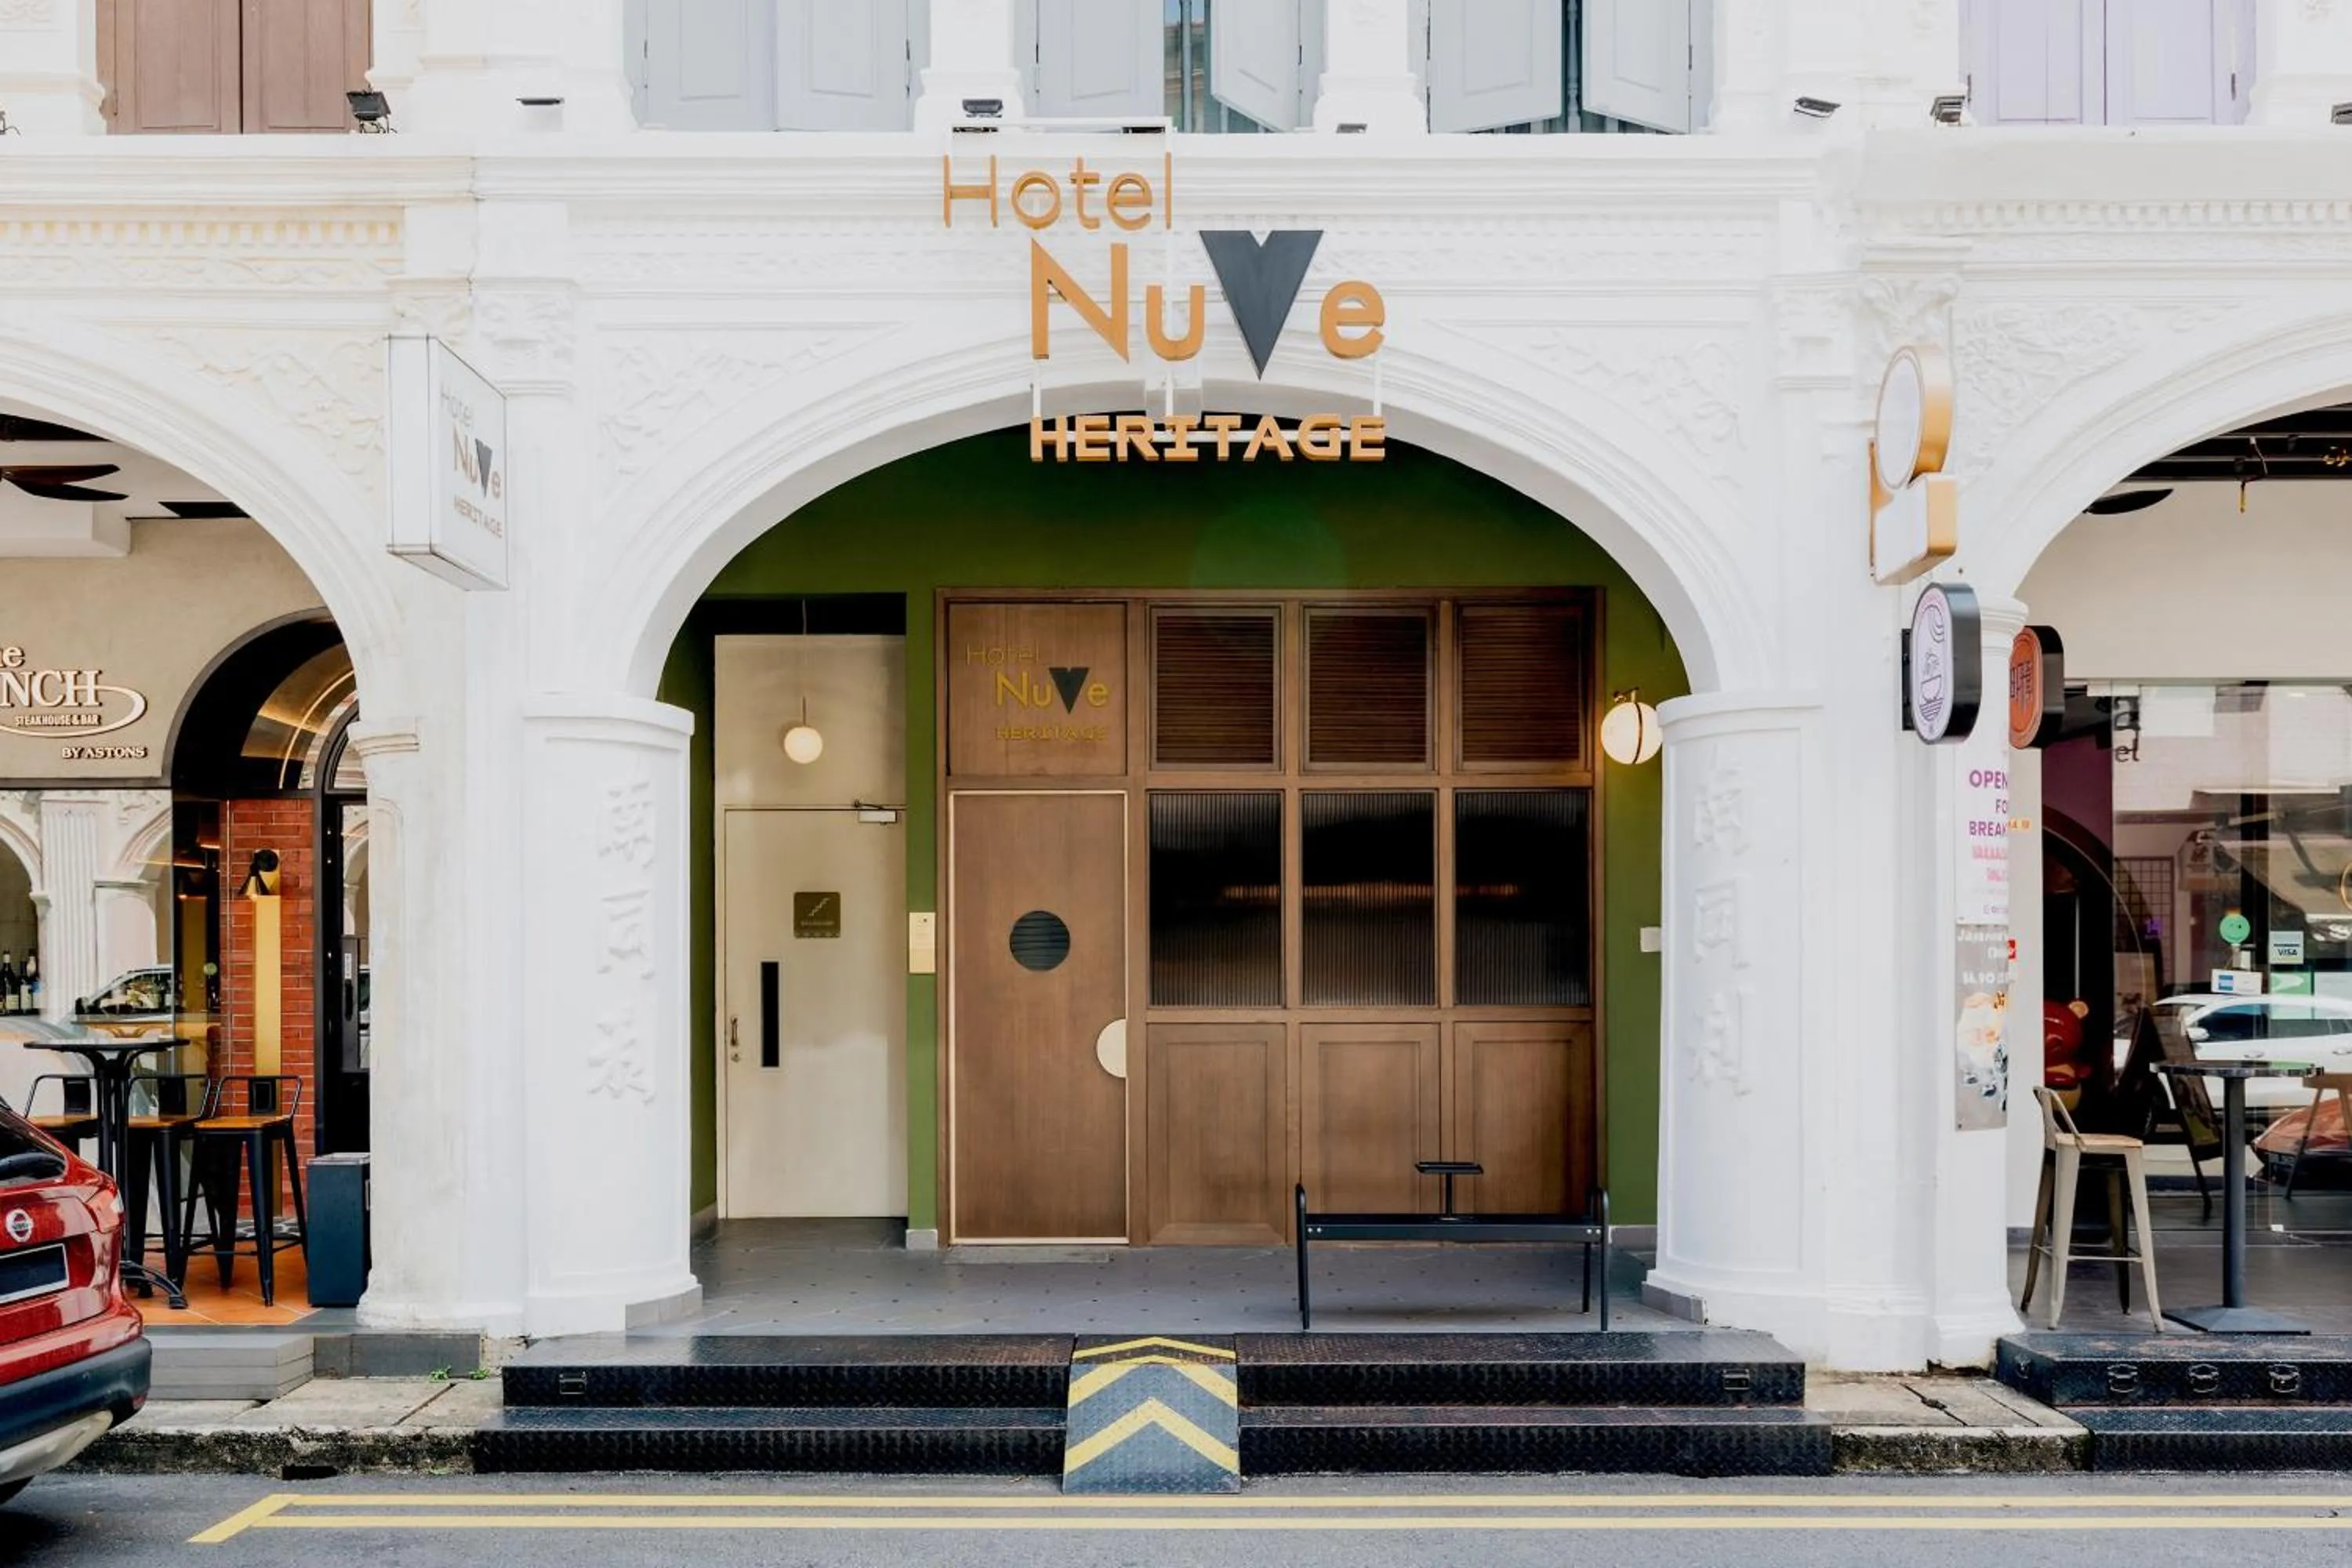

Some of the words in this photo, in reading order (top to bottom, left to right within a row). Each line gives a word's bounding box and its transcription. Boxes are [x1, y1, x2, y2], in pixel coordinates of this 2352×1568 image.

[943, 151, 1171, 230] Hotel
[1029, 413, 1385, 462] HERITAGE
[453, 495, 503, 539] HERITAGE
[967, 641, 1040, 666] Hotel
[81, 714, 101, 726] BAR
[996, 726, 1109, 741] HERITAGE
[62, 746, 85, 759] BY
[85, 746, 148, 759] ASTONS
